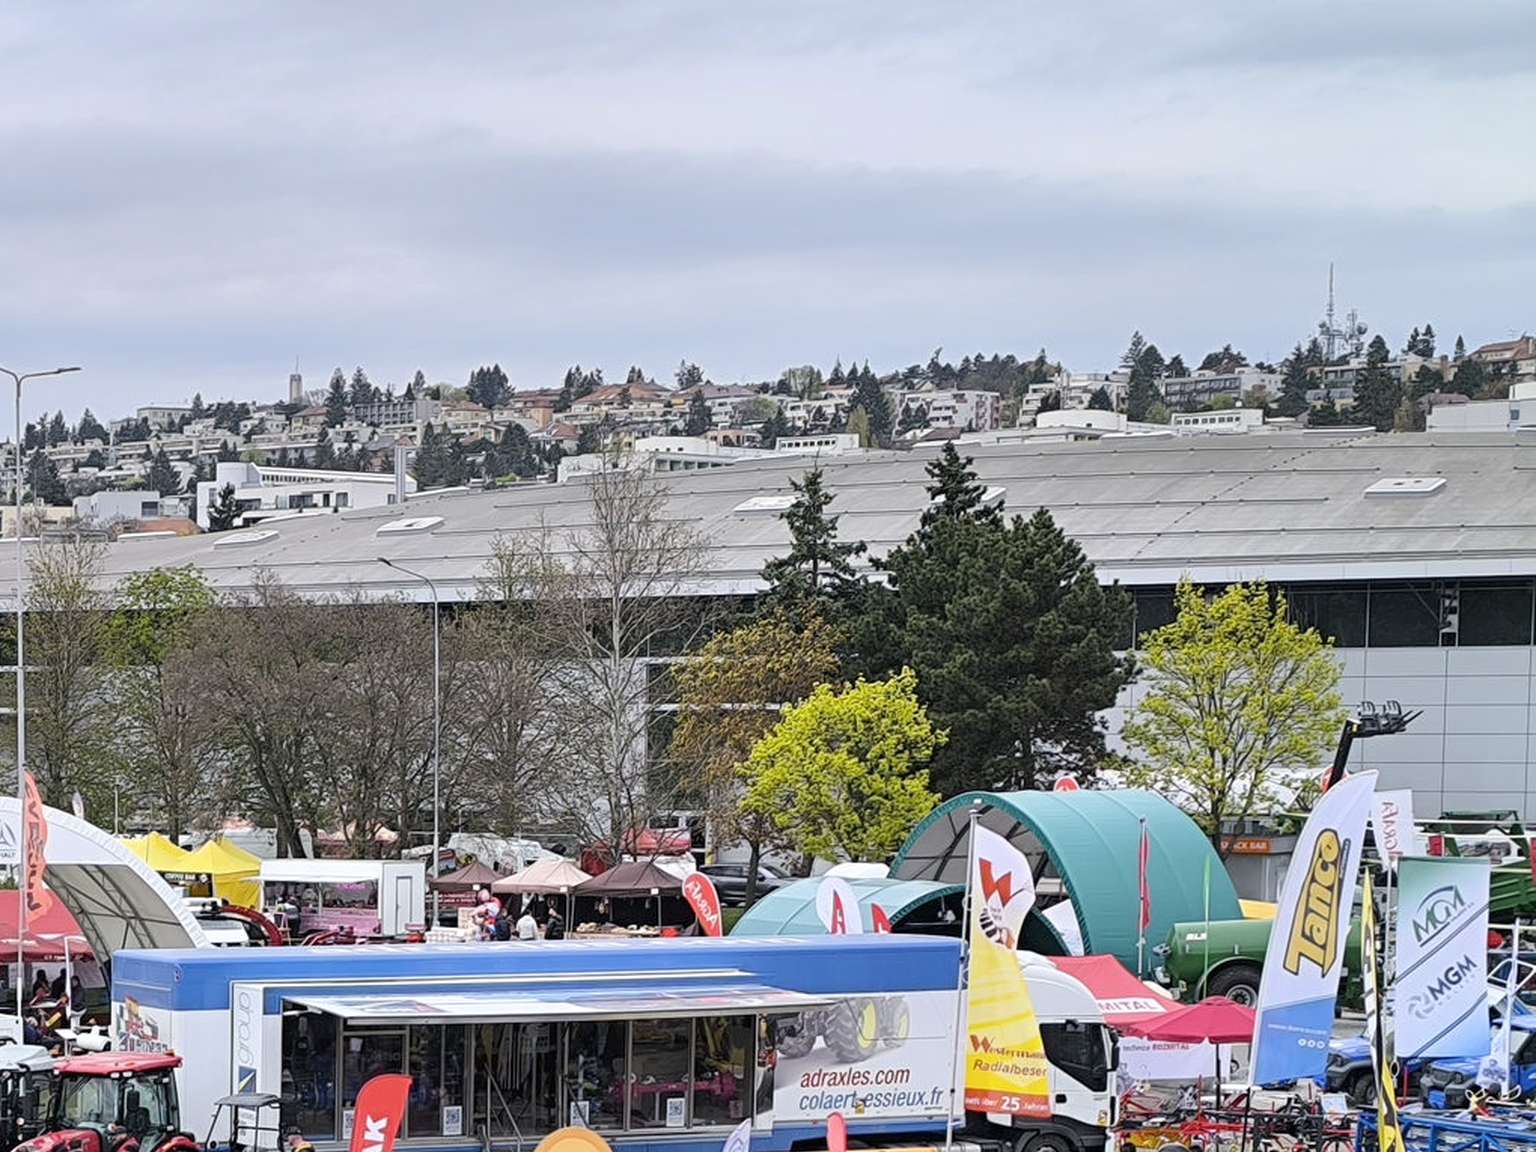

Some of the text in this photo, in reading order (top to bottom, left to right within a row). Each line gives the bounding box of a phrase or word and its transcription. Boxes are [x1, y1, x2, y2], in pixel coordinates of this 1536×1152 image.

[1283, 828, 1340, 978] Tanco
[1427, 954, 1478, 999] MGM
[800, 1067, 911, 1088] adraxles.com
[1001, 1096, 1021, 1111] 25
